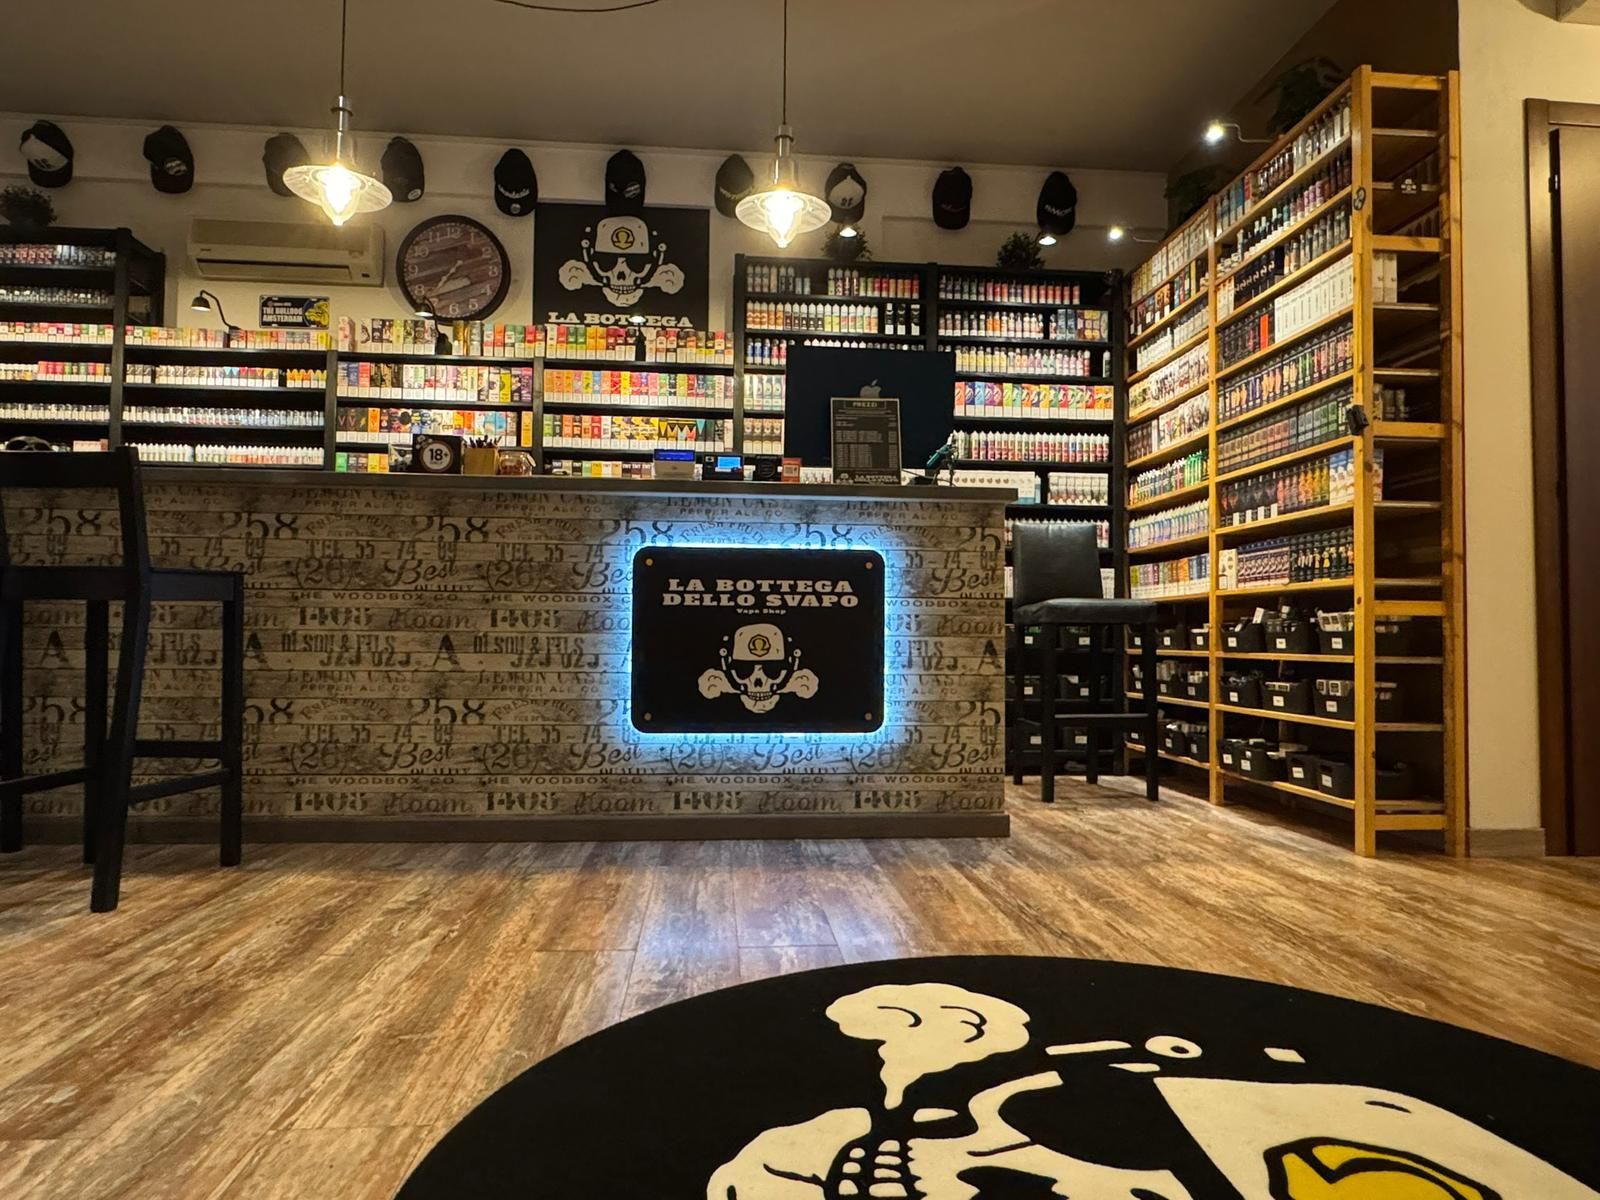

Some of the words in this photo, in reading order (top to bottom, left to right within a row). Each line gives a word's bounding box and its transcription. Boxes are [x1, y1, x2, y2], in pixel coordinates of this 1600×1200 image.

[414, 284, 425, 296] 8
[449, 303, 459, 315] 6
[468, 298, 479, 310] 5
[548, 312, 580, 323] LA
[584, 313, 693, 327] BOTEGA
[429, 448, 449, 461] 18+
[219, 511, 298, 539] 258
[411, 515, 489, 543] 258
[600, 519, 673, 546] 258
[382, 558, 457, 587] Best
[668, 578, 705, 591] LA
[716, 579, 853, 593] BOTTEGA
[932, 567, 998, 595] Best
[332, 592, 423, 601] WOODBOX
[523, 595, 611, 604] WOODBOX
[662, 593, 755, 606] DELLO
[766, 594, 859, 607] SVAPO
[432, 634, 463, 670] A
[978, 639, 1002, 672] A
[408, 698, 485, 725] 258
[379, 742, 453, 772] Best
[570, 742, 641, 771] Best
[753, 742, 824, 771] Best
[931, 742, 998, 771] Best
[329, 777, 420, 785] WOODBOX
[519, 777, 609, 785] WOODBOX
[705, 776, 792, 784] WOODBOX
[885, 775, 969, 784] WOODBOX
